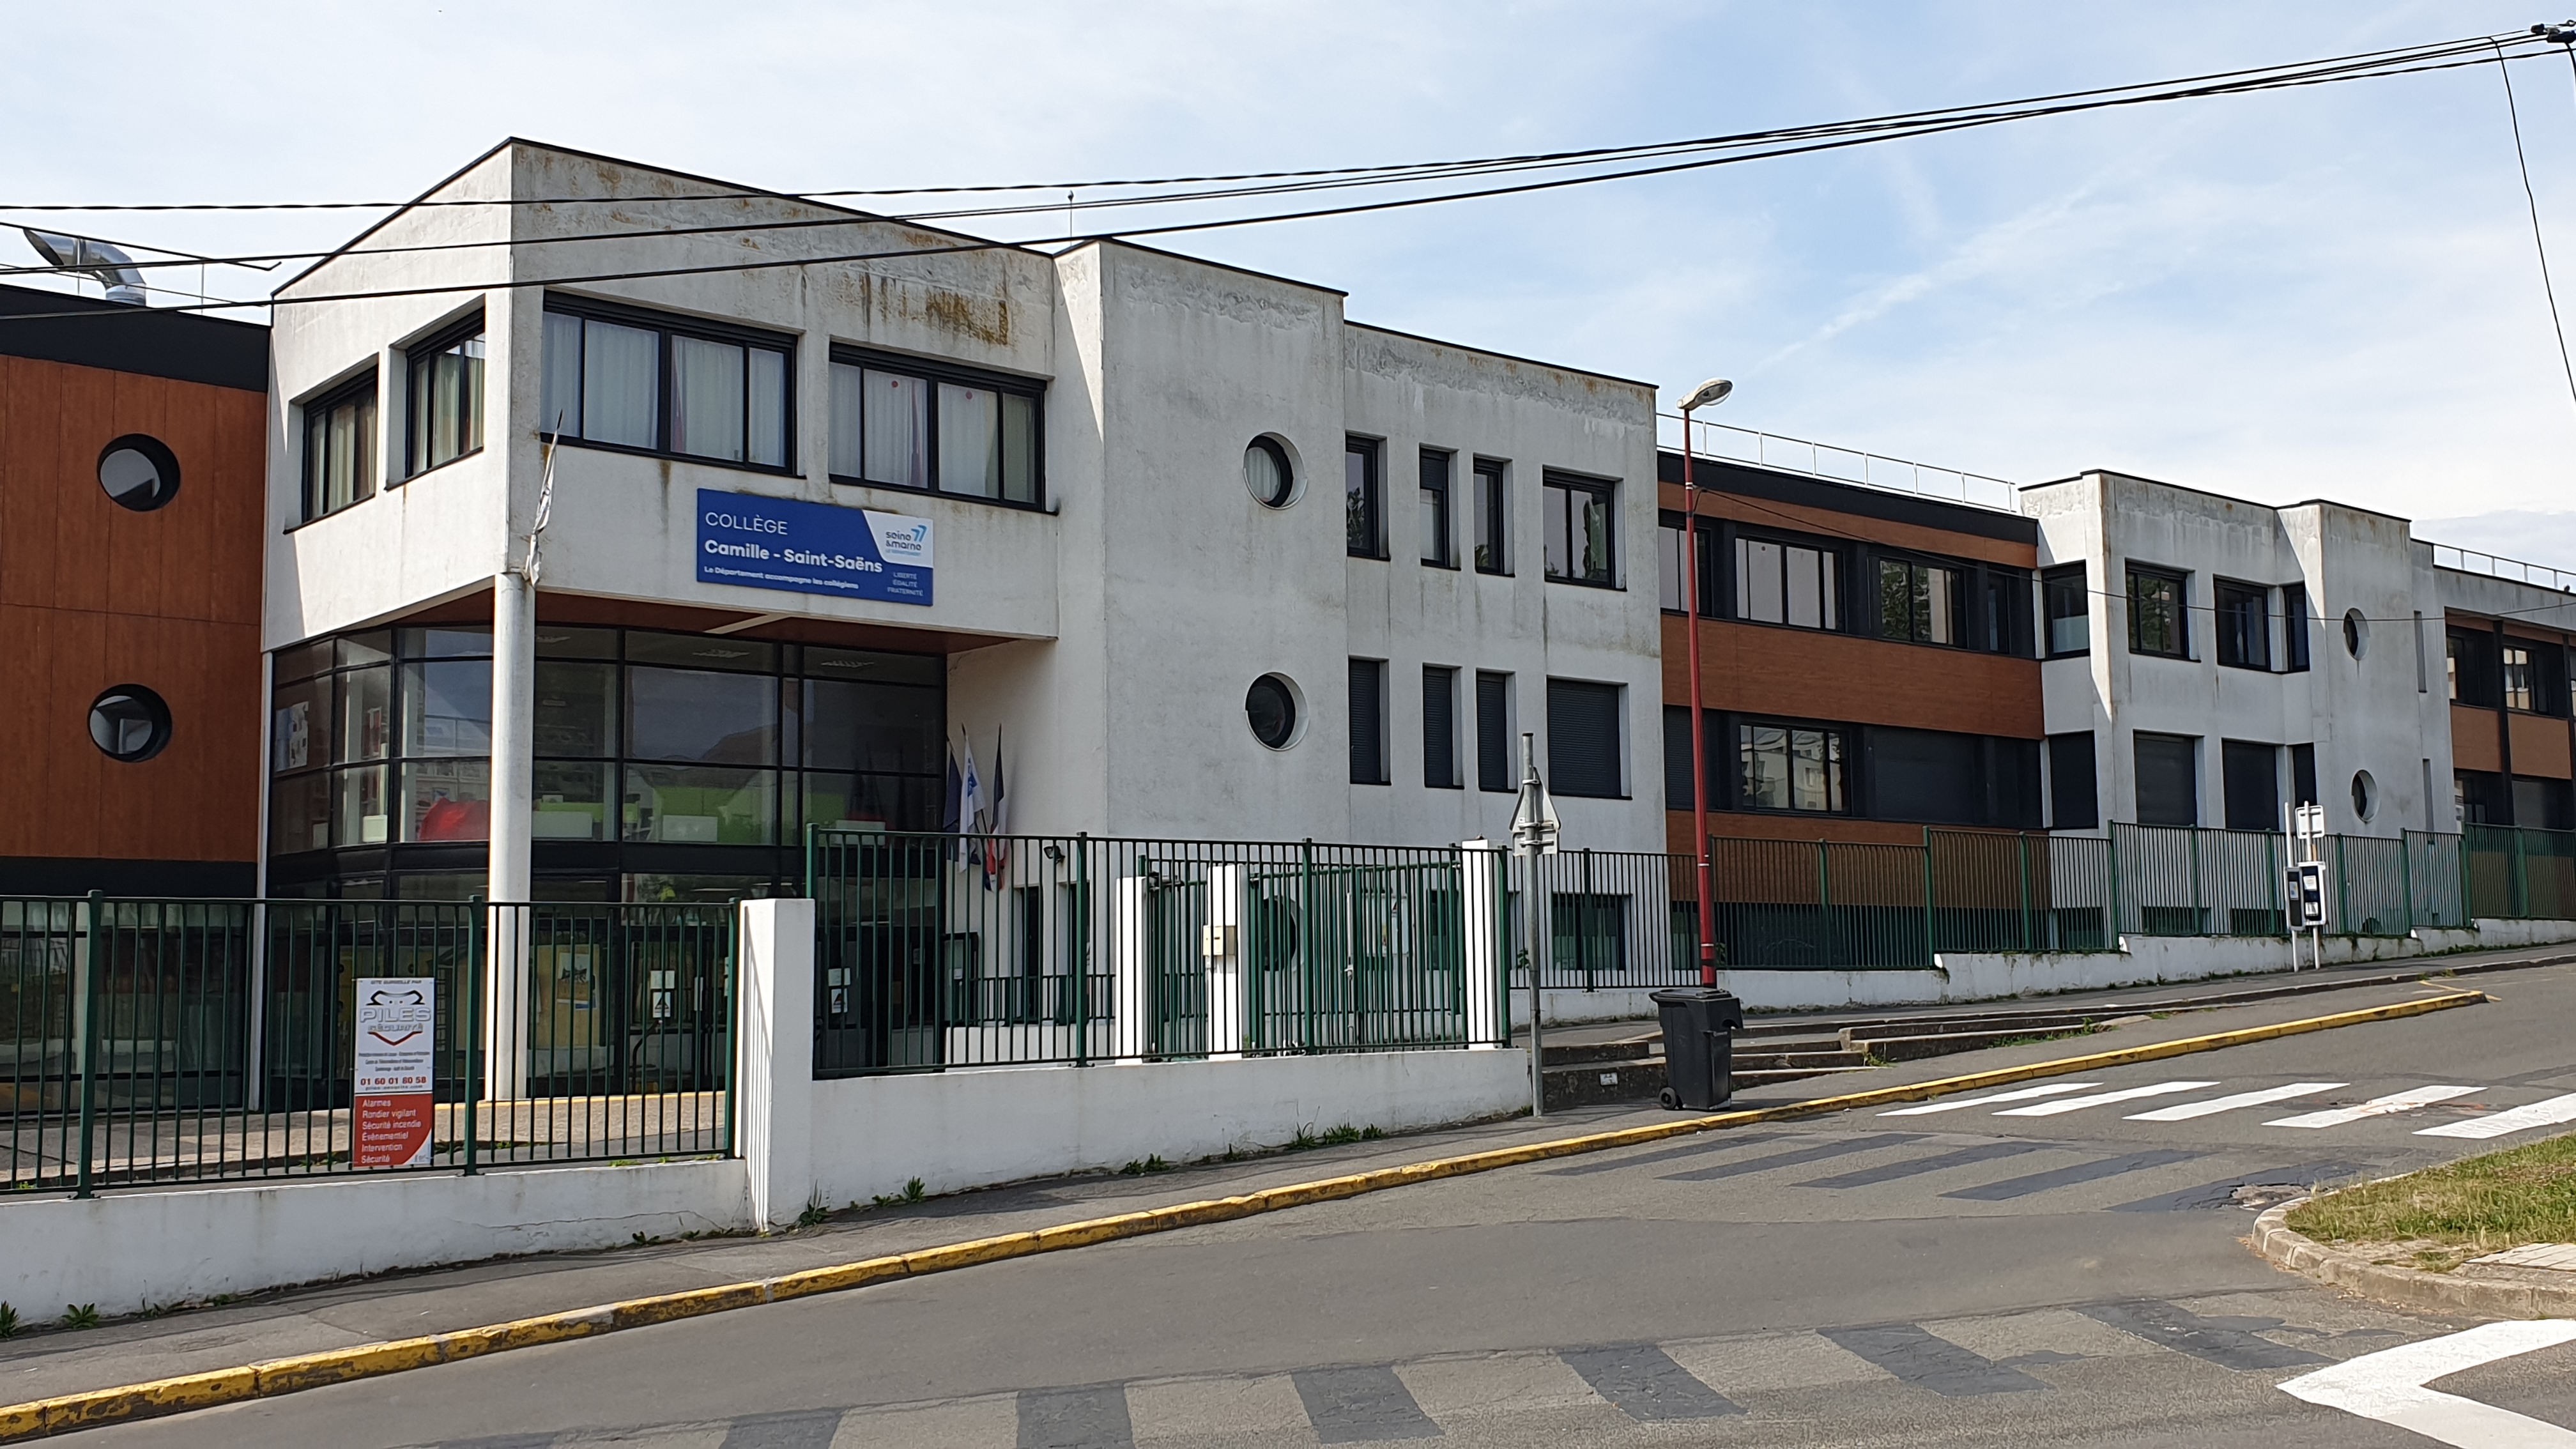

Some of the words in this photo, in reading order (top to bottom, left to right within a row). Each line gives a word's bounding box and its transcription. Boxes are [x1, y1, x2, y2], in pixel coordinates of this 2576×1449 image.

[705, 512, 788, 535] COLLÈGE
[705, 539, 770, 560] Camille
[784, 548, 882, 573] Saint-Saëns
[715, 567, 764, 579] Département
[765, 573, 812, 584] accompagne
[813, 578, 824, 586] les
[824, 579, 859, 589] collégiens
[360, 1007, 431, 1023] PILES
[362, 1099, 392, 1107] Alarmes
[362, 1110, 390, 1119] Rondier
[391, 1108, 417, 1119] vigilant
[362, 1121, 391, 1130] Sécurité
[392, 1119, 422, 1128] incendie
[362, 1144, 403, 1153] Intervention
[361, 1154, 390, 1163] Sécurité
